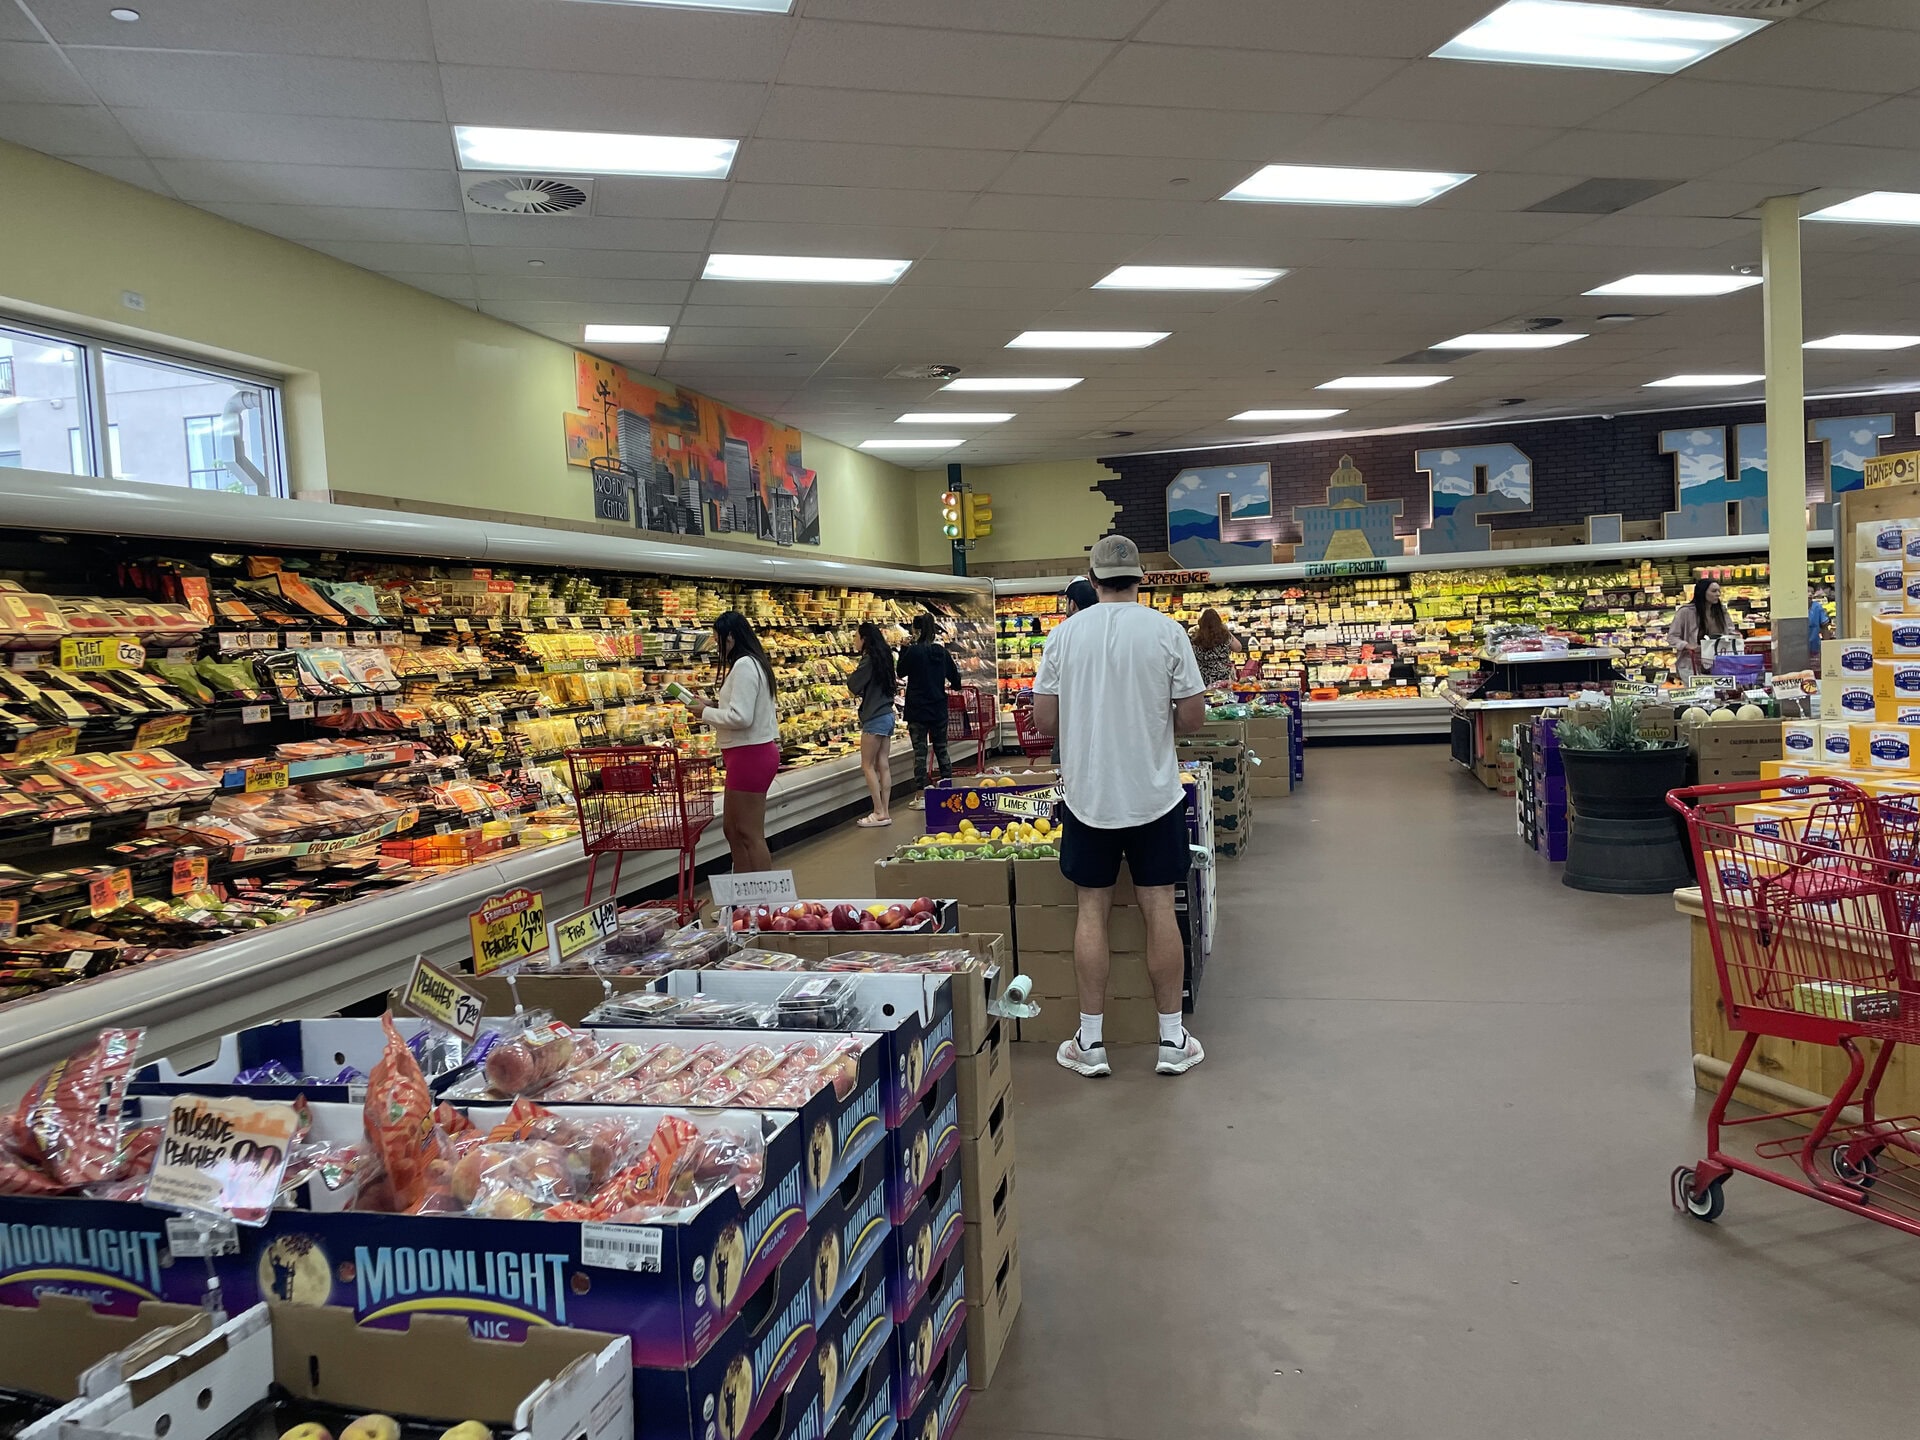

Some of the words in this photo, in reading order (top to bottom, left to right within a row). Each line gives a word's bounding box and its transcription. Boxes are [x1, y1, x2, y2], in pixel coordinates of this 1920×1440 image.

[1003, 798, 1028, 811] LIMES
[480, 926, 519, 961] PEACHES
[566, 920, 586, 943] FIGS
[416, 969, 455, 1010] PEACHES
[172, 1105, 235, 1144] PALISADE
[837, 1078, 880, 1156] MOONLIGHT
[164, 1137, 227, 1169] PEACHES
[744, 1160, 802, 1264] MOONLIGHT
[844, 1179, 885, 1267] MOONLIGHT
[761, 1223, 788, 1260] ORGANIC
[354, 1246, 570, 1324] MOONLIGHT
[755, 1275, 813, 1396] MOONLIGHT
[842, 1276, 886, 1374] MOONLIGHT
[772, 1342, 798, 1383] ORGANIC
